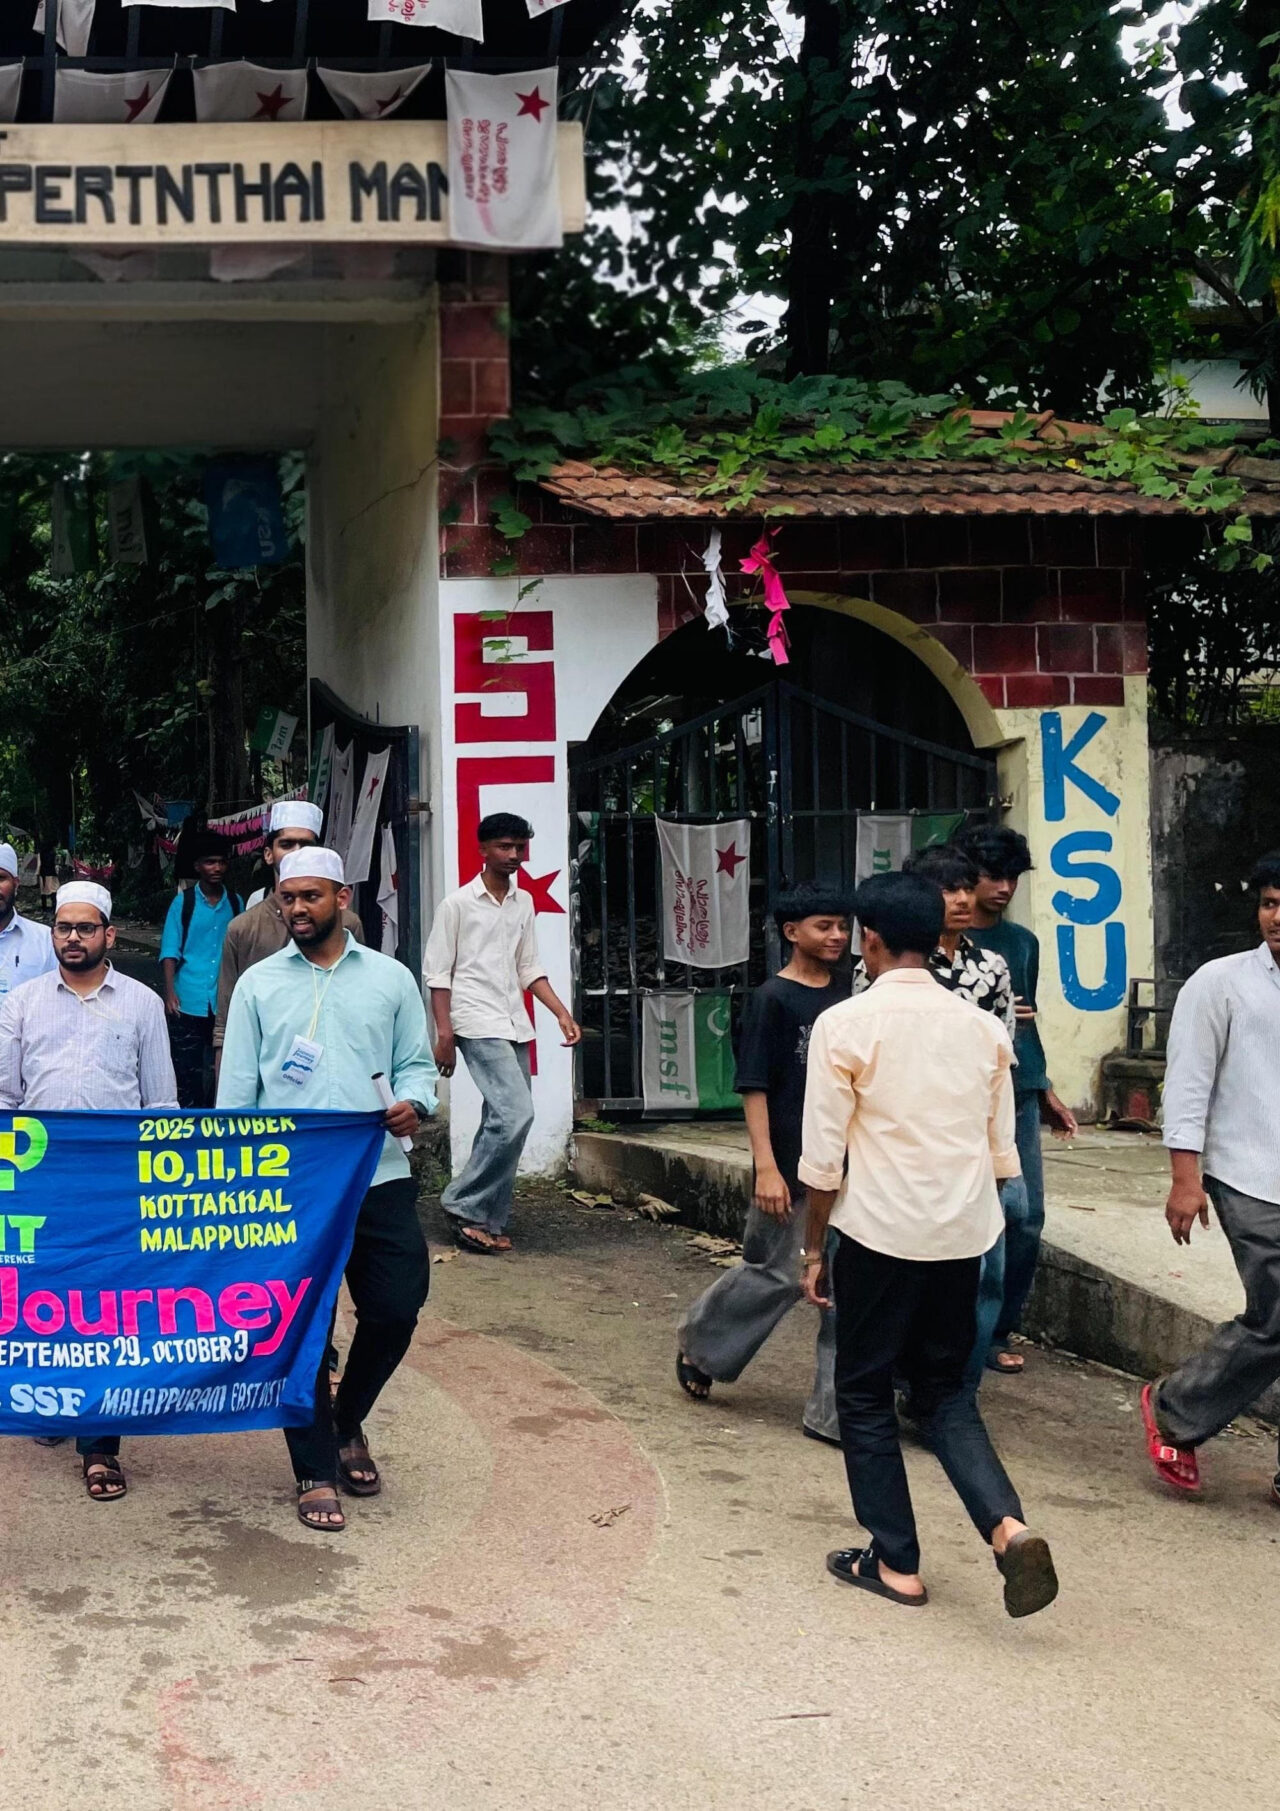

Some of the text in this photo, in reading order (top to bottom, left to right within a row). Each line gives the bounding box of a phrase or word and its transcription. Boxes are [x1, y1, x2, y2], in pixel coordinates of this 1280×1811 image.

[1041, 712, 1127, 1011] KSU
[659, 1019, 691, 1100] msf
[139, 1117, 196, 1141] 2025
[138, 1143, 291, 1187] 10,11,12
[139, 1187, 293, 1220] KOTTAKKAL
[140, 1219, 298, 1252] MALAPPURAM
[10, 1384, 86, 1417] SSF
[99, 1385, 225, 1417] MALAPPURAM
